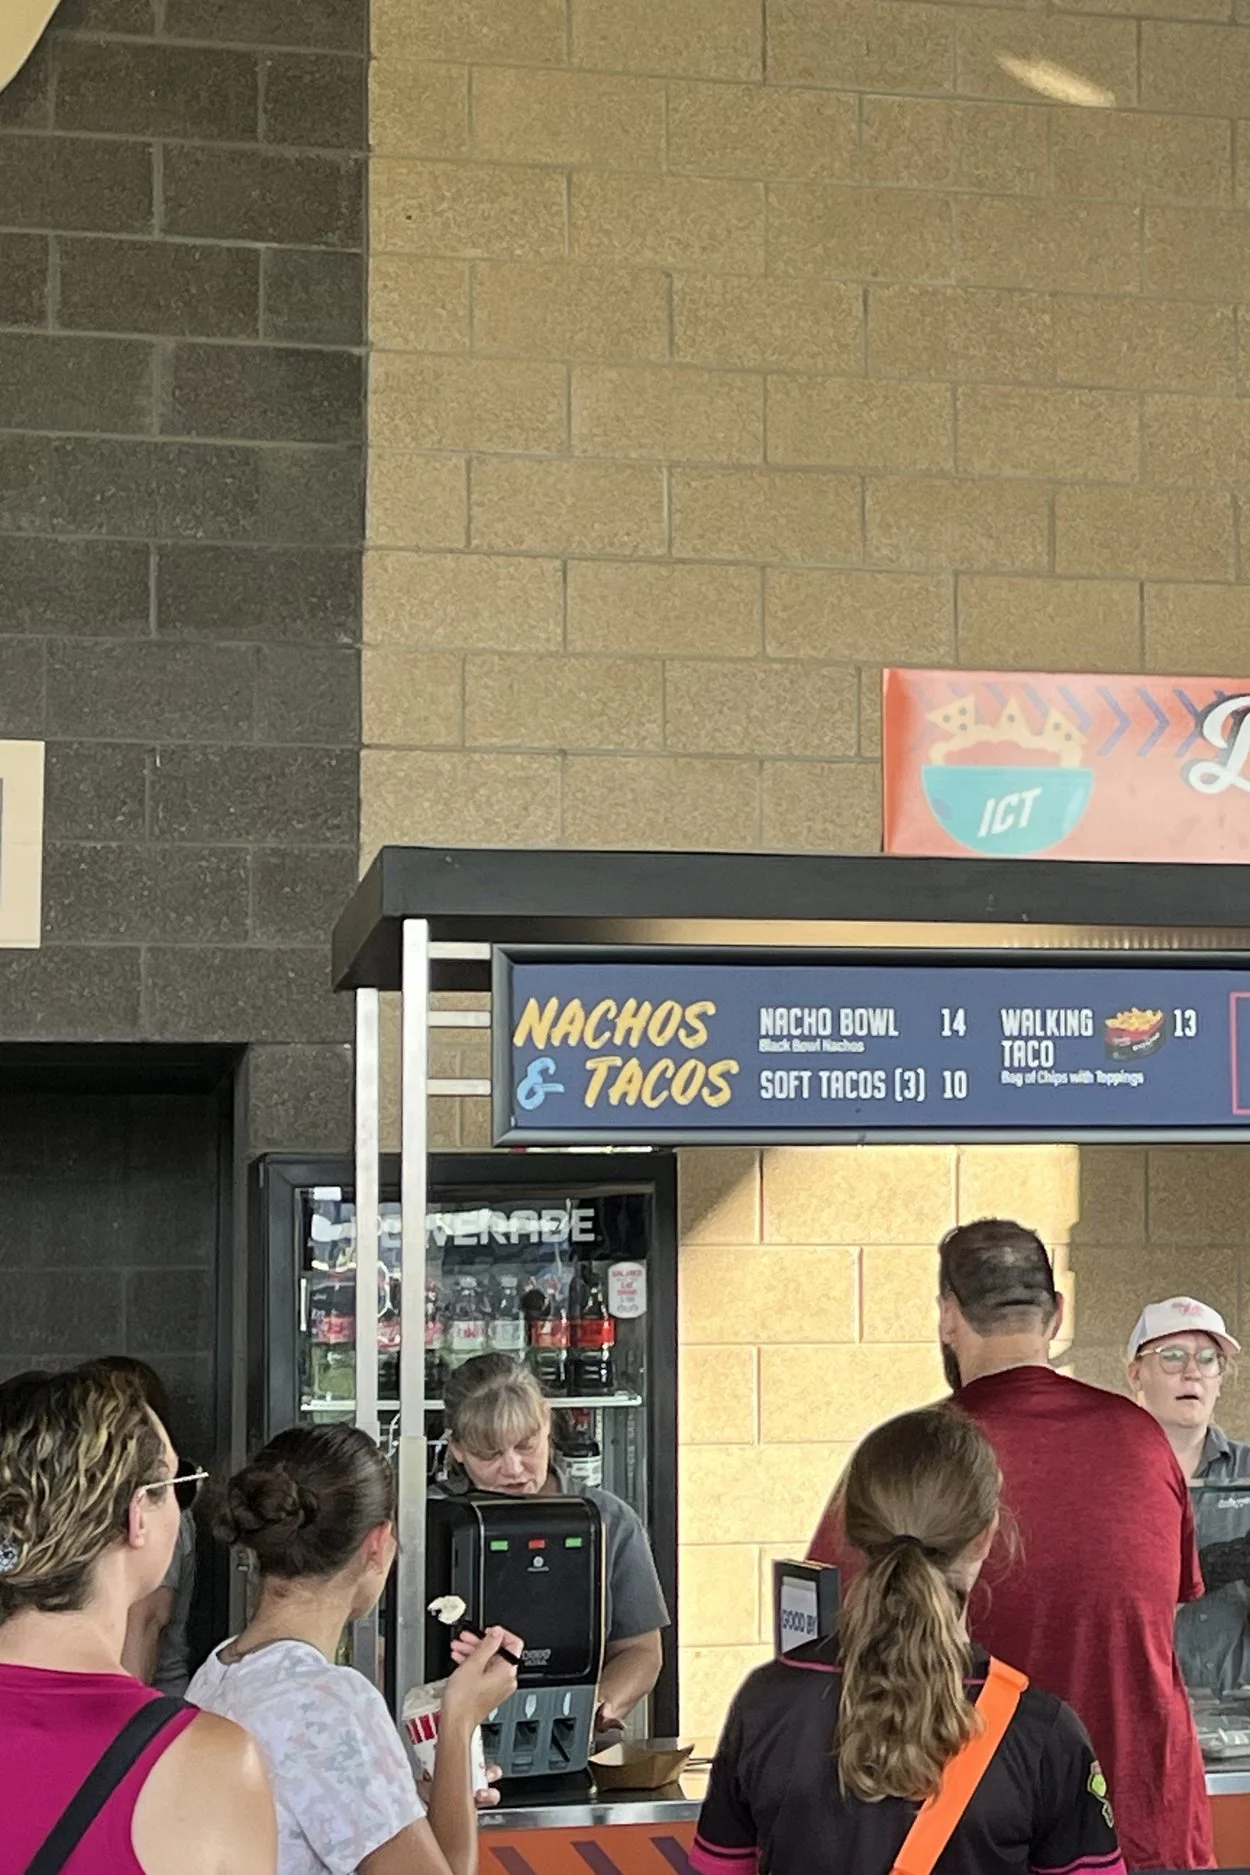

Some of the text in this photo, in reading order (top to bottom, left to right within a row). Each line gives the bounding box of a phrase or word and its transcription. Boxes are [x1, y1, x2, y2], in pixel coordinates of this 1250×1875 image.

[977, 787, 1042, 839] ICT
[513, 997, 717, 1049] NACHOS
[760, 1007, 899, 1036] NACHO BOWL
[941, 1008, 966, 1037] 14
[1001, 1008, 1094, 1037] WALKING
[1173, 1008, 1197, 1037] 13
[758, 1038, 865, 1052] Black Bowl Nachos
[1001, 1040, 1054, 1068] TACO
[516, 1056, 740, 1110] & TACOS
[760, 1070, 812, 1099] SOFT
[818, 1070, 886, 1099] TACOS
[942, 1070, 967, 1099] 10
[1001, 1068, 1144, 1087] Bag of Chips with Toppings
